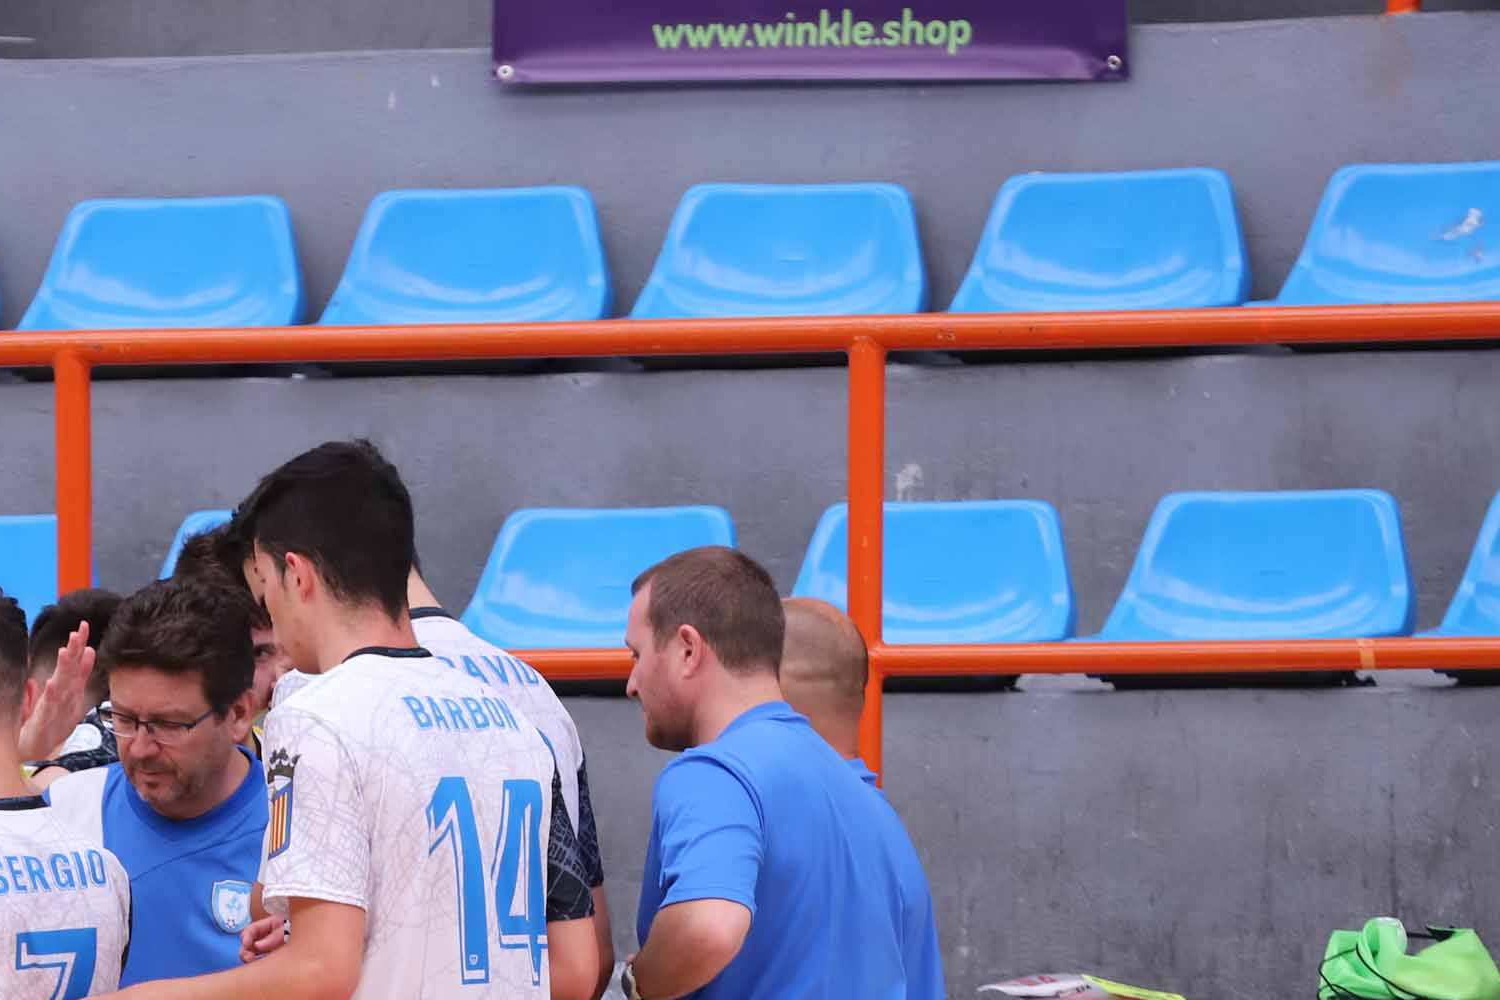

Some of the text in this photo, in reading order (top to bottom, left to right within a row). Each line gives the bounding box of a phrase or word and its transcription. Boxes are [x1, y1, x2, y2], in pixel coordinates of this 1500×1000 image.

[652, 9, 972, 55] www.winkle.shop
[403, 686, 519, 732] BARBÓN
[425, 776, 549, 987] 14
